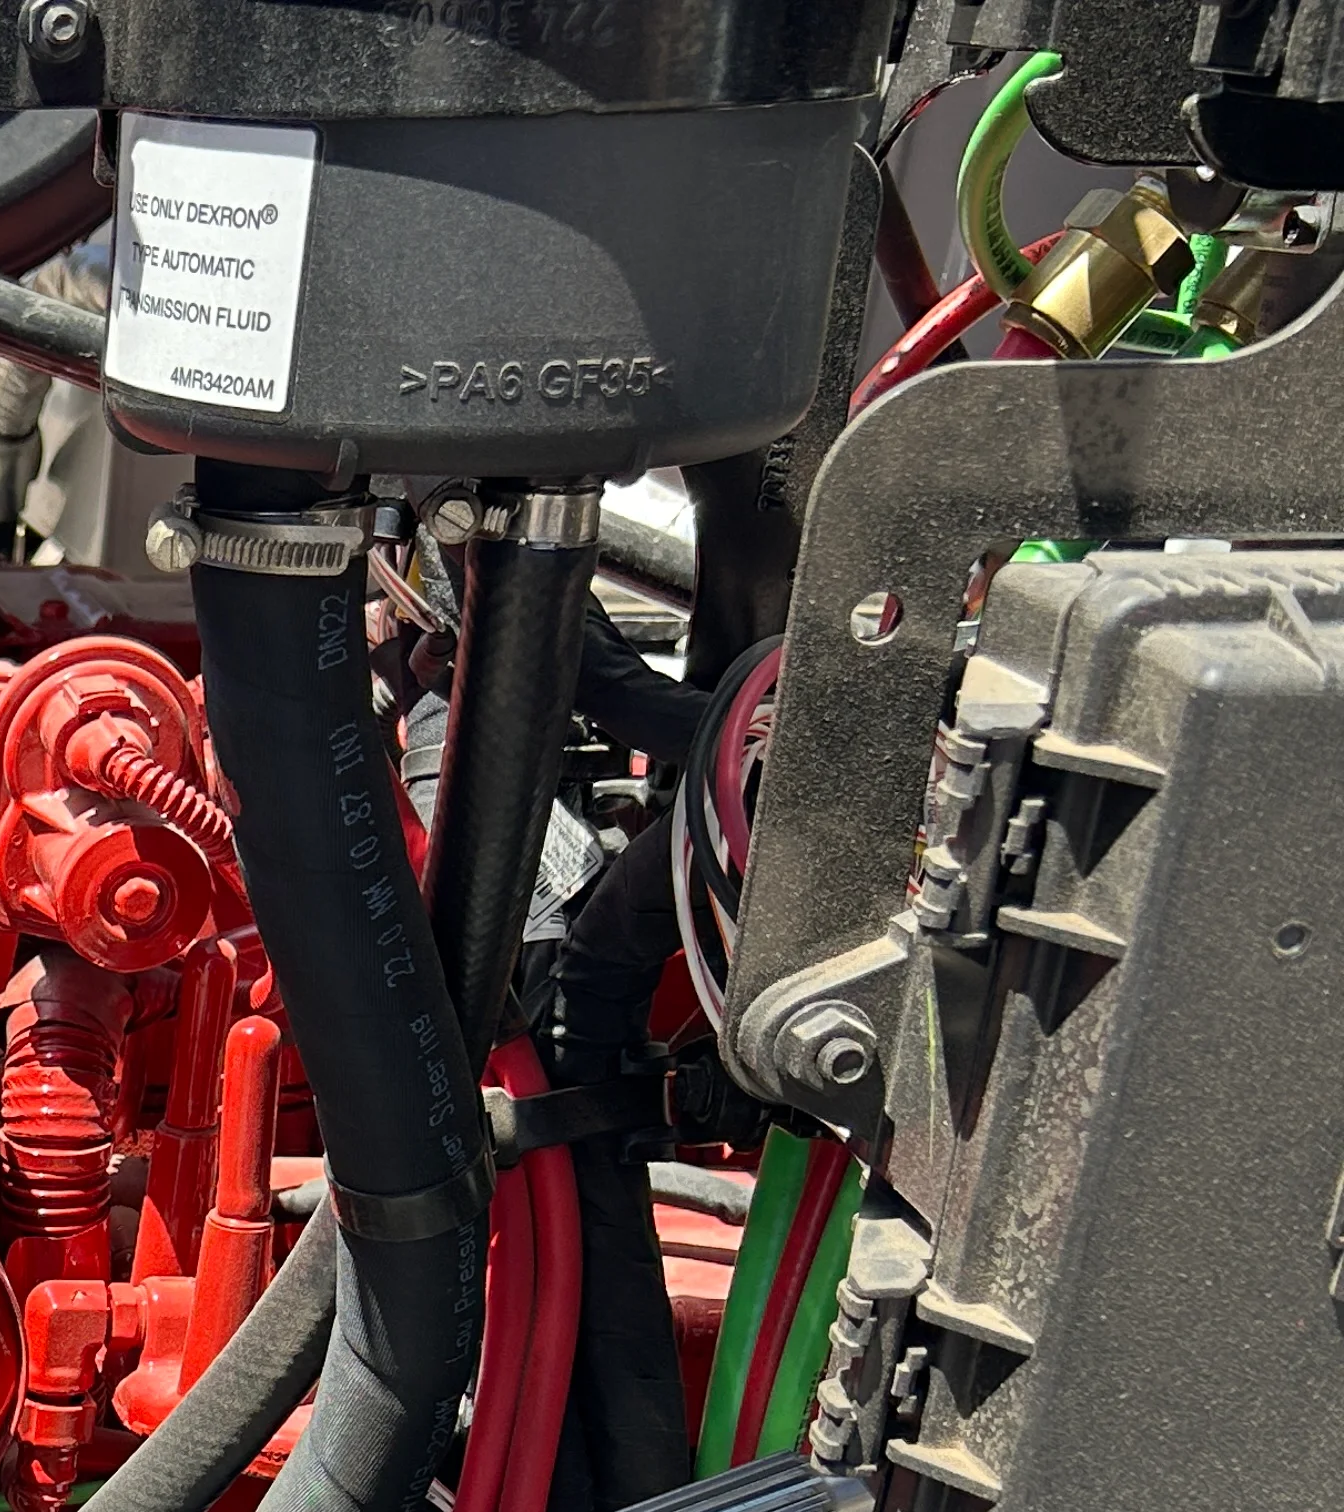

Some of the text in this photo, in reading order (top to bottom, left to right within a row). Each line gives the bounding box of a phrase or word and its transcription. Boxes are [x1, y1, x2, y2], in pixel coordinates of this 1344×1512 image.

[130, 192, 278, 230] USE ONLY DEXRON®
[132, 241, 255, 280] TYPE AUTOMATIC
[121, 285, 271, 332] TRANSMISSION FLUID
[170, 367, 275, 400] 4MR3420AM
[317, 589, 349, 671] DN22
[359, 874, 398, 919] MM
[375, 922, 415, 987] 22.0
[408, 1012, 456, 1126] Steering
[454, 1218, 476, 1312] Pressur
[444, 1319, 472, 1363] Low
